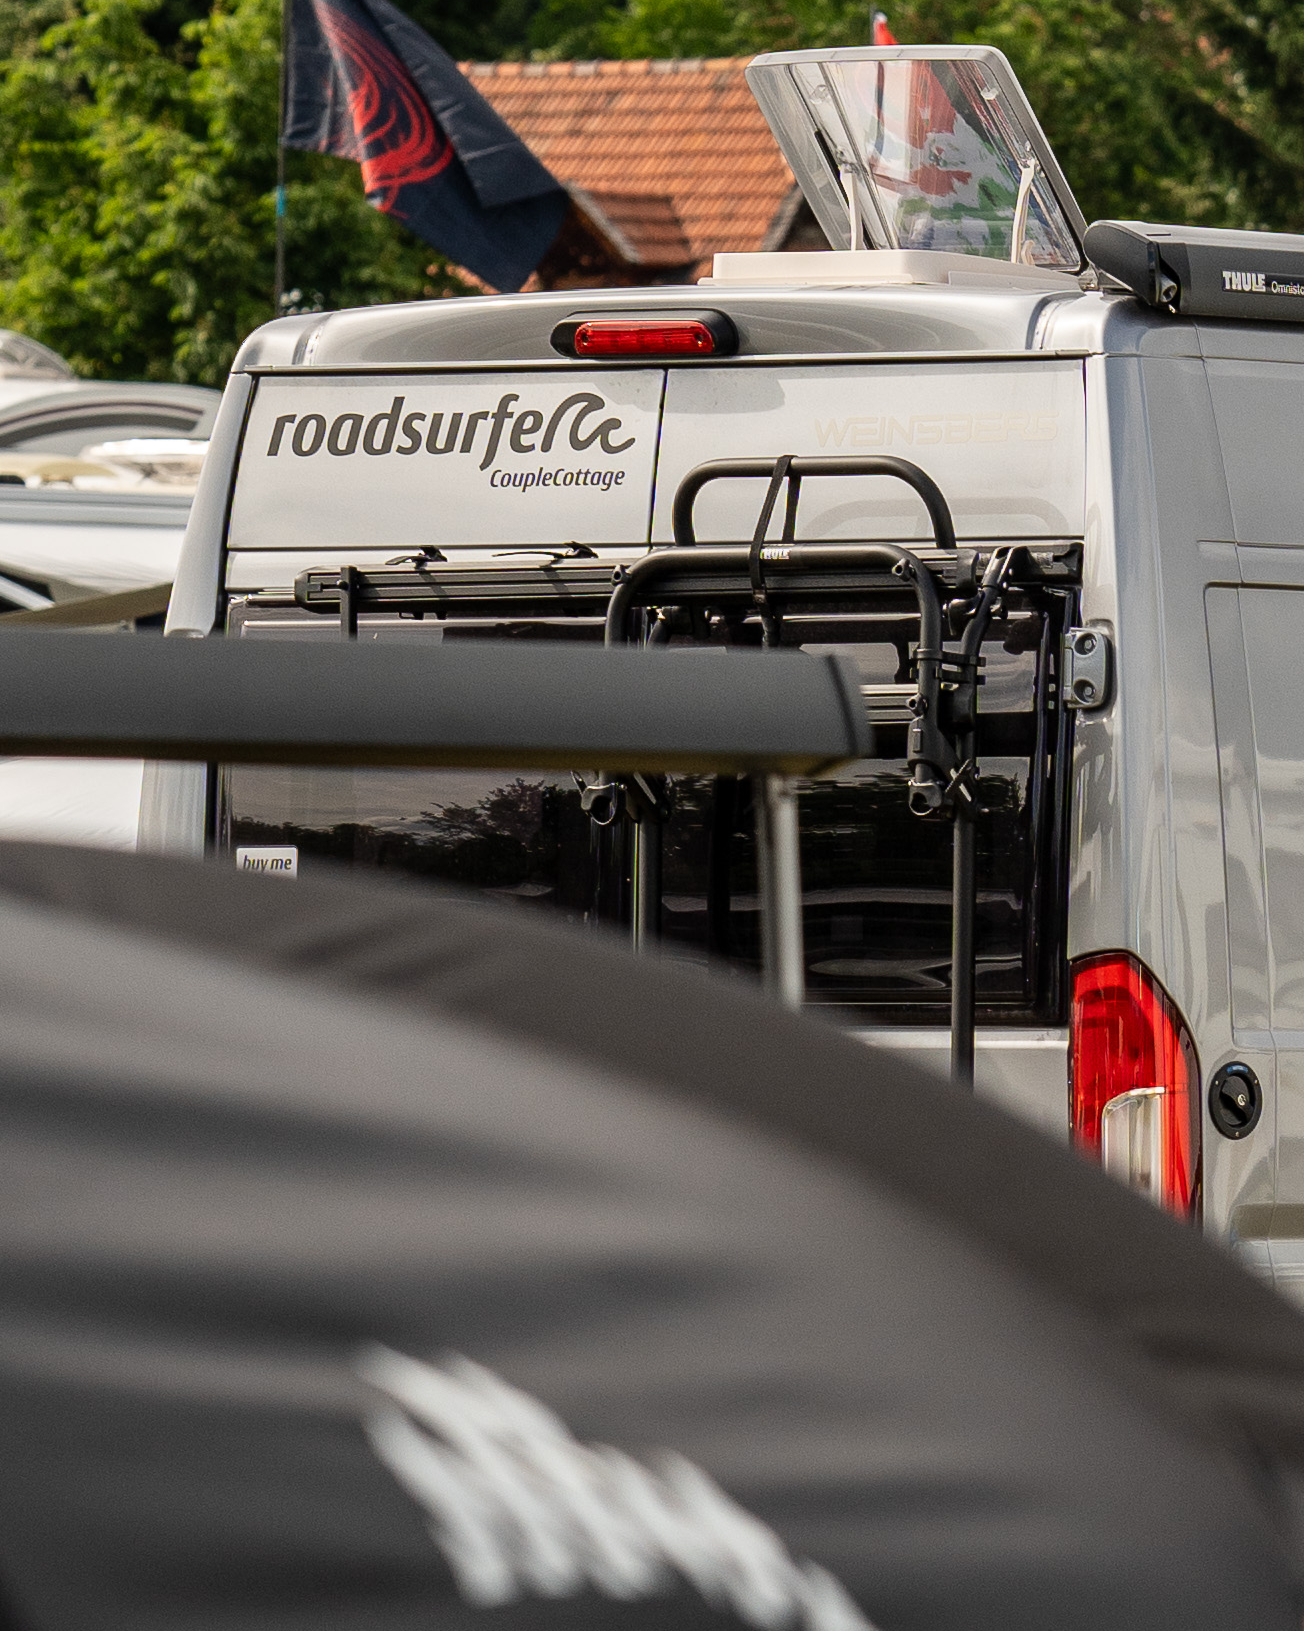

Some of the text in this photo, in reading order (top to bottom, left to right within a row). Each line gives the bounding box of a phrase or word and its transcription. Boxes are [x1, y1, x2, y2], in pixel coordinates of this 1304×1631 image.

[1222, 270, 1266, 292] THULE
[814, 410, 1060, 448] WEINSBERG
[489, 467, 626, 492] CoupleCottage
[243, 854, 292, 873] buy me
